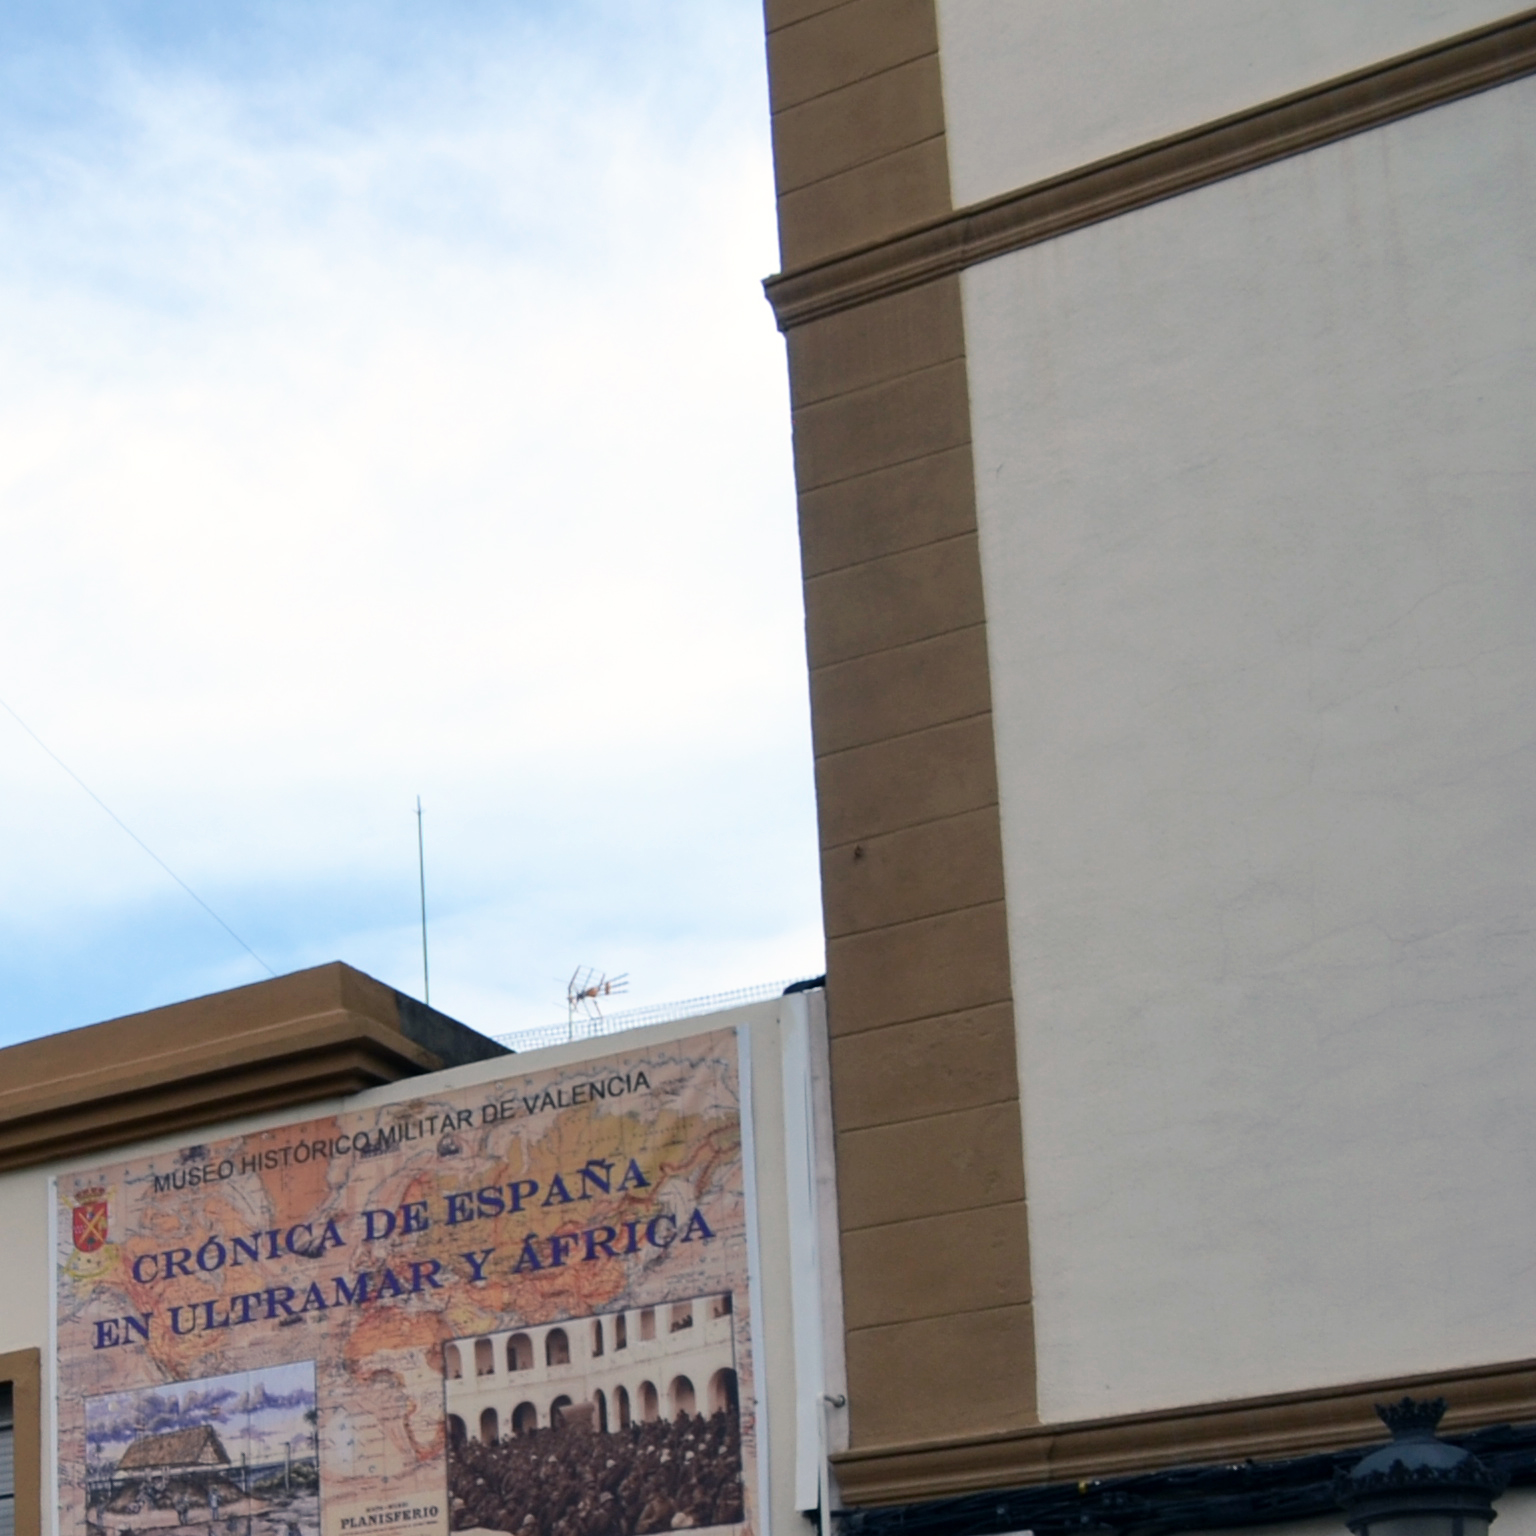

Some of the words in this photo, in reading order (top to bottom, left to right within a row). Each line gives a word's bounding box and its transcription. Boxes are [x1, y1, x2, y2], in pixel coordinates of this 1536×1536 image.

[154, 1159, 234, 1193] MUSEO
[241, 1131, 370, 1175] HISTÓRICO
[378, 1109, 473, 1146] MILITAR
[482, 1100, 515, 1124] DE
[523, 1070, 651, 1115] VALENCIA
[93, 1312, 154, 1350] EN
[167, 1259, 444, 1335] ULTRAMAR
[461, 1248, 496, 1284] Y
[512, 1207, 716, 1275] ÁFRICA
[132, 1217, 346, 1284] CRÓNICA
[361, 1200, 429, 1243] DE
[443, 1158, 651, 1226] ESPAÑA
[340, 1505, 439, 1530] PLANISFERIO
